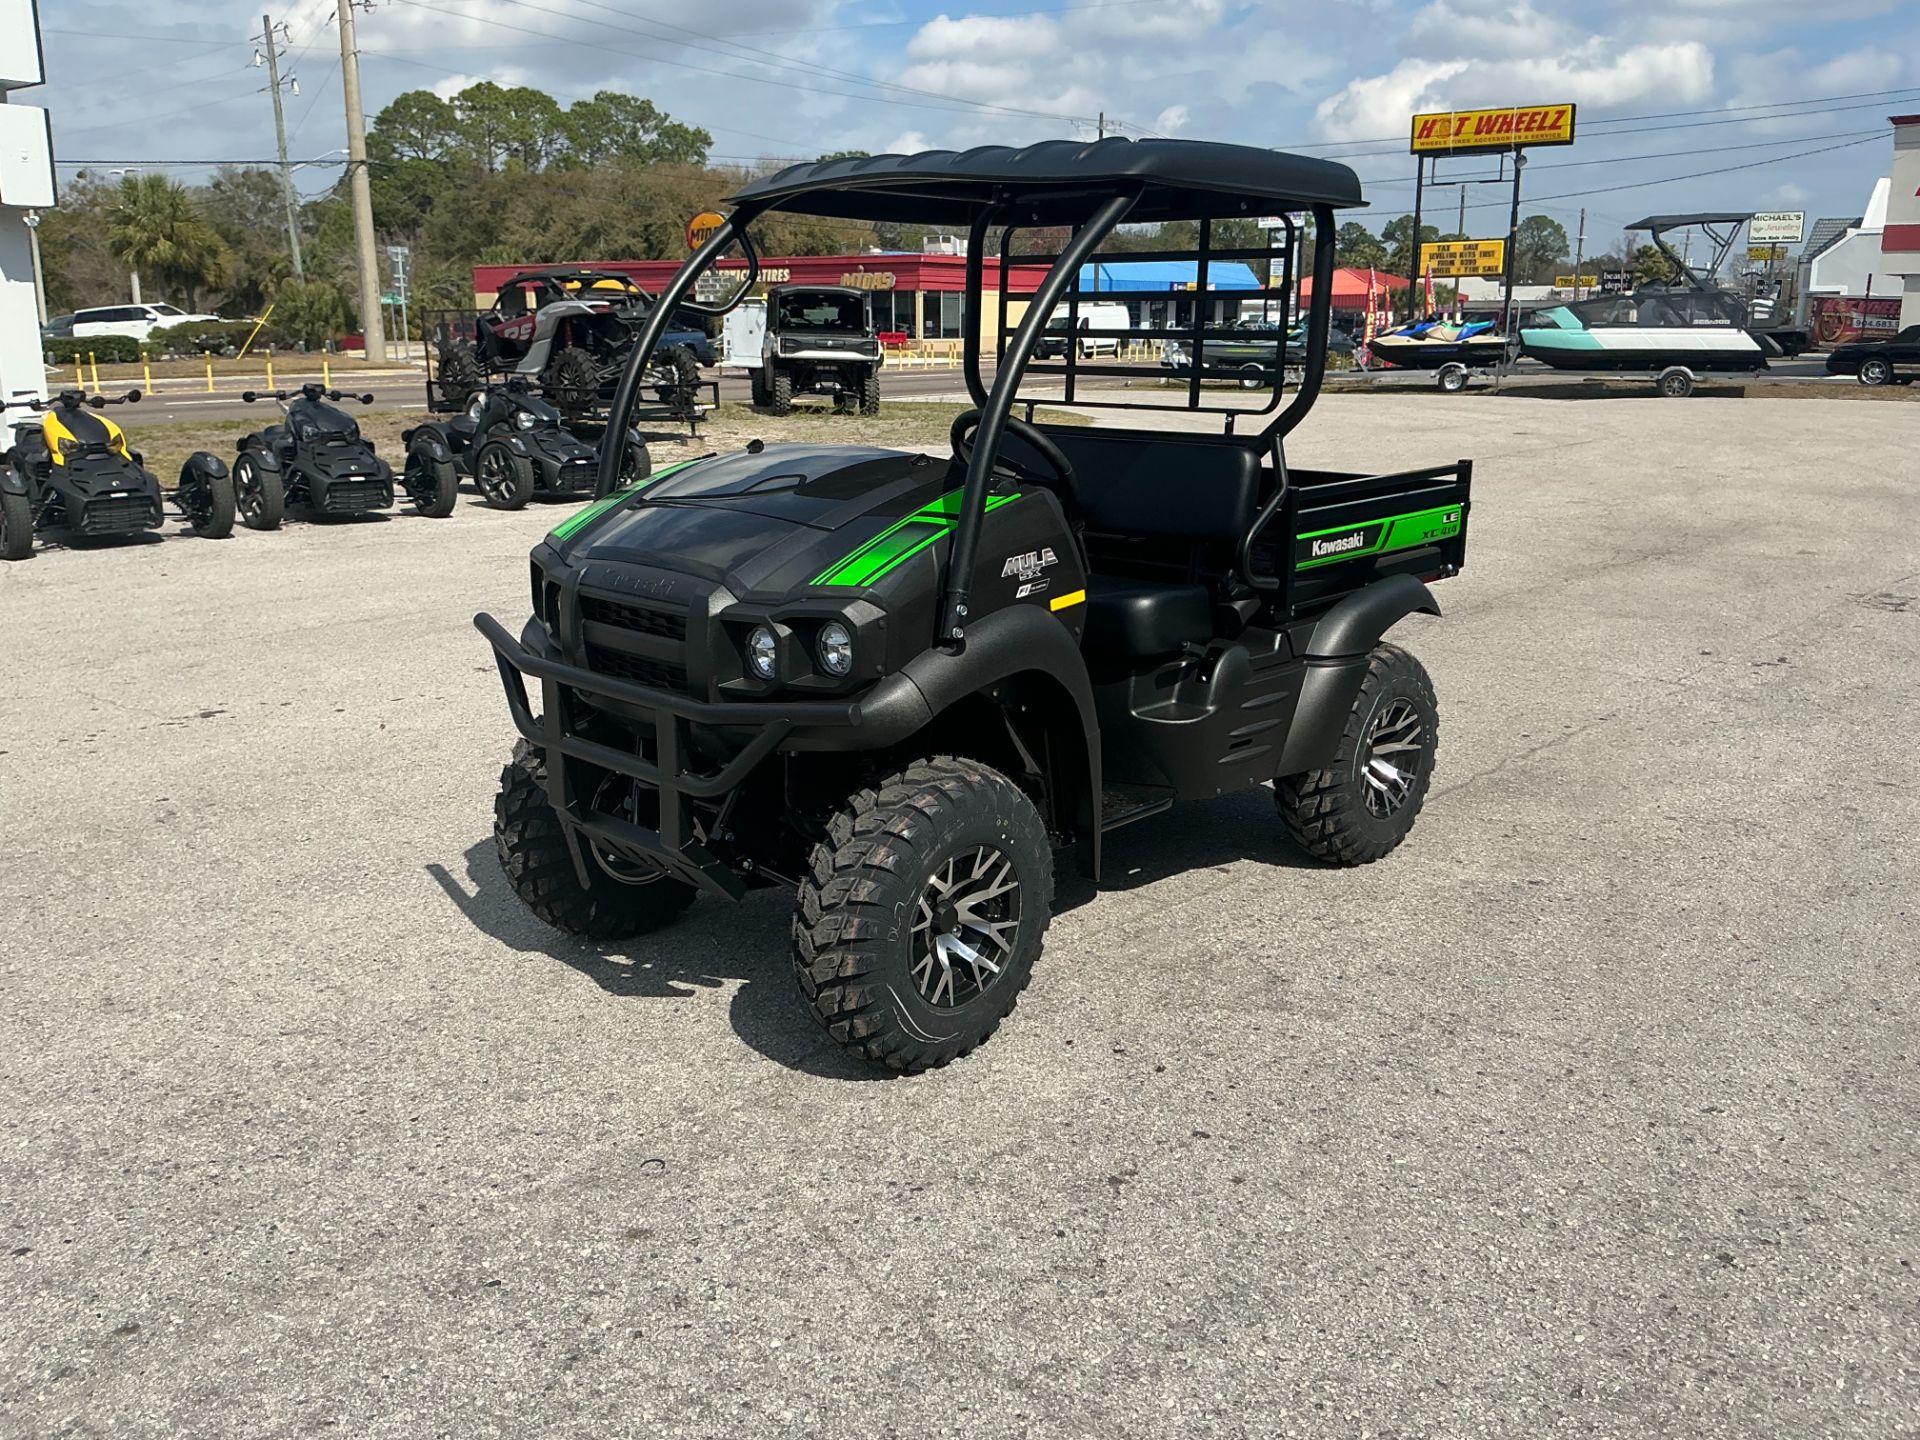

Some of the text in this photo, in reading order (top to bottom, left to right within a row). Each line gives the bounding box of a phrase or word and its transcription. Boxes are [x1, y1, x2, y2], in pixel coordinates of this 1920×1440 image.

[1474, 109, 1567, 135] WHEELZ
[1419, 139, 1448, 147] WHEELS
[1473, 134, 1522, 143] ACCESSORIES
[762, 268, 790, 283] TIRES
[1442, 512, 1459, 524] LE
[1312, 531, 1364, 557] Kawasaki
[1001, 547, 1059, 578] MULE
